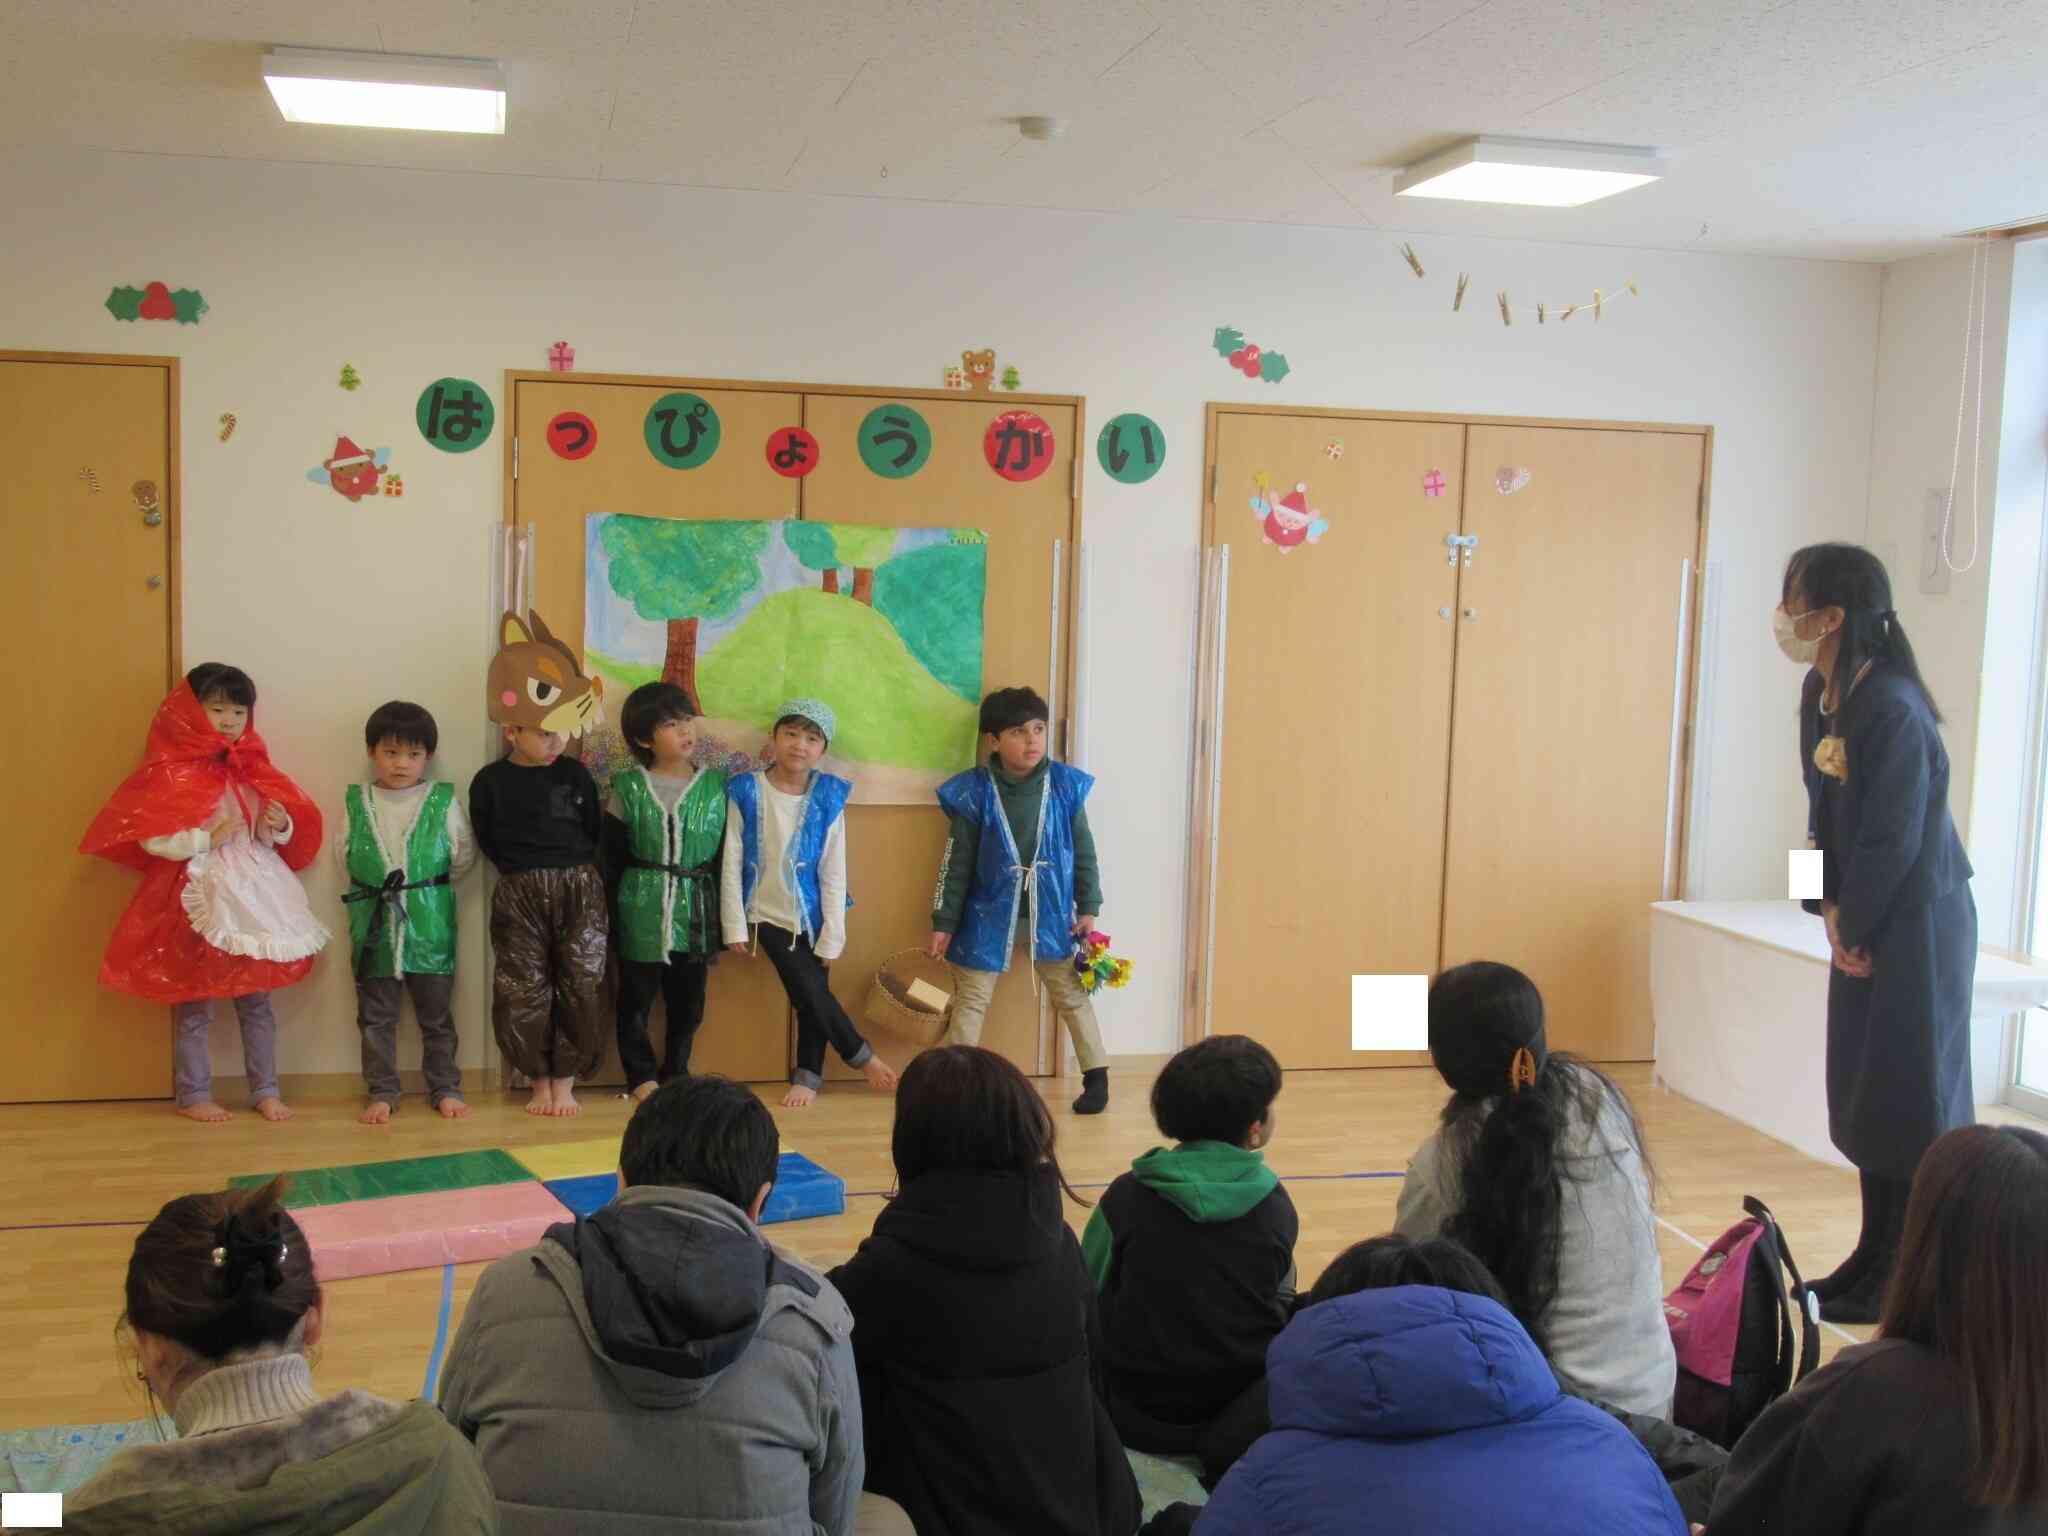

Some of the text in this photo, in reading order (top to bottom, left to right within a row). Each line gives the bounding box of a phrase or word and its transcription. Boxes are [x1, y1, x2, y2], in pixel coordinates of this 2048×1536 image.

[427, 385, 1156, 473] はっぴょうかい
